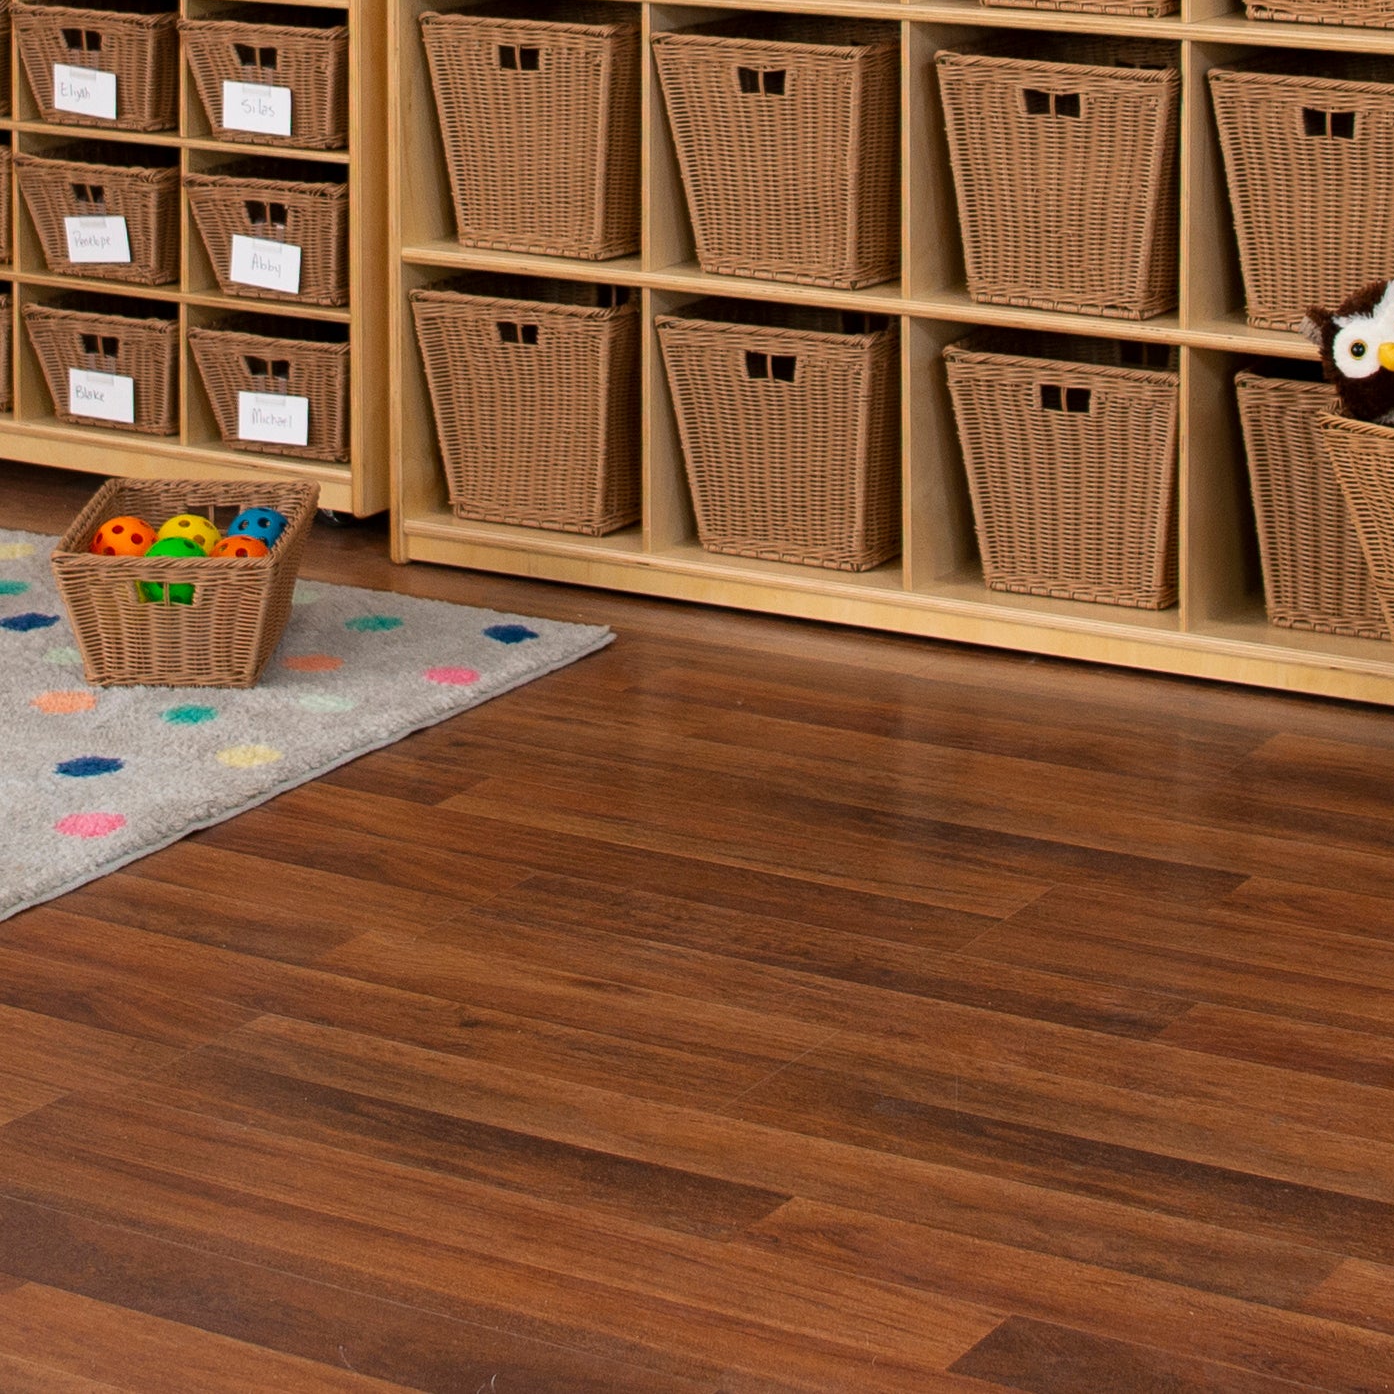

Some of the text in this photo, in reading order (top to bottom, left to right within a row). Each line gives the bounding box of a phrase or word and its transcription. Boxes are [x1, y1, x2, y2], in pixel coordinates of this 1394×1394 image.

[241, 98, 276, 117] Silas
[251, 253, 282, 279] Abby
[75, 385, 105, 403] Blake
[251, 408, 293, 429] Michael
